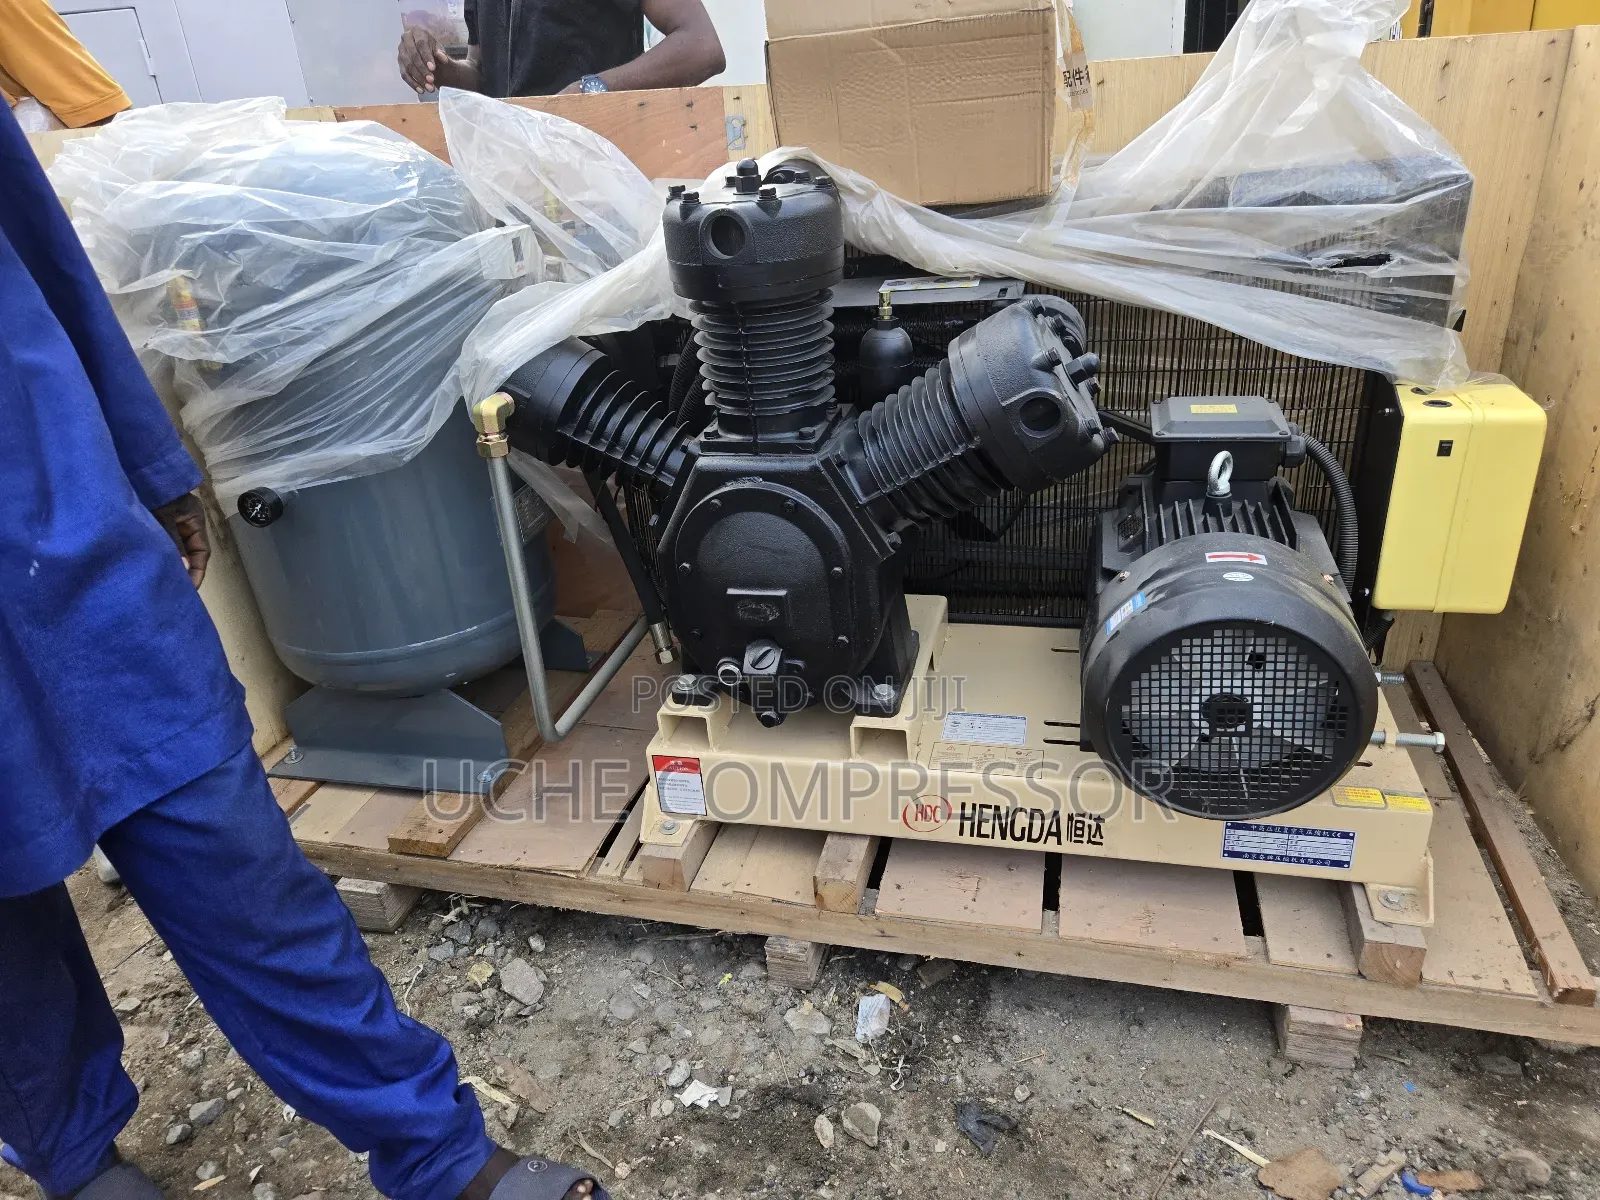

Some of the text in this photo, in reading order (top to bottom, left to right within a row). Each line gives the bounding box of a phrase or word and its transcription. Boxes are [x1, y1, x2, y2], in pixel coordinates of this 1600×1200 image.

[914, 801, 1106, 847] HDC HENGDA 恒达
